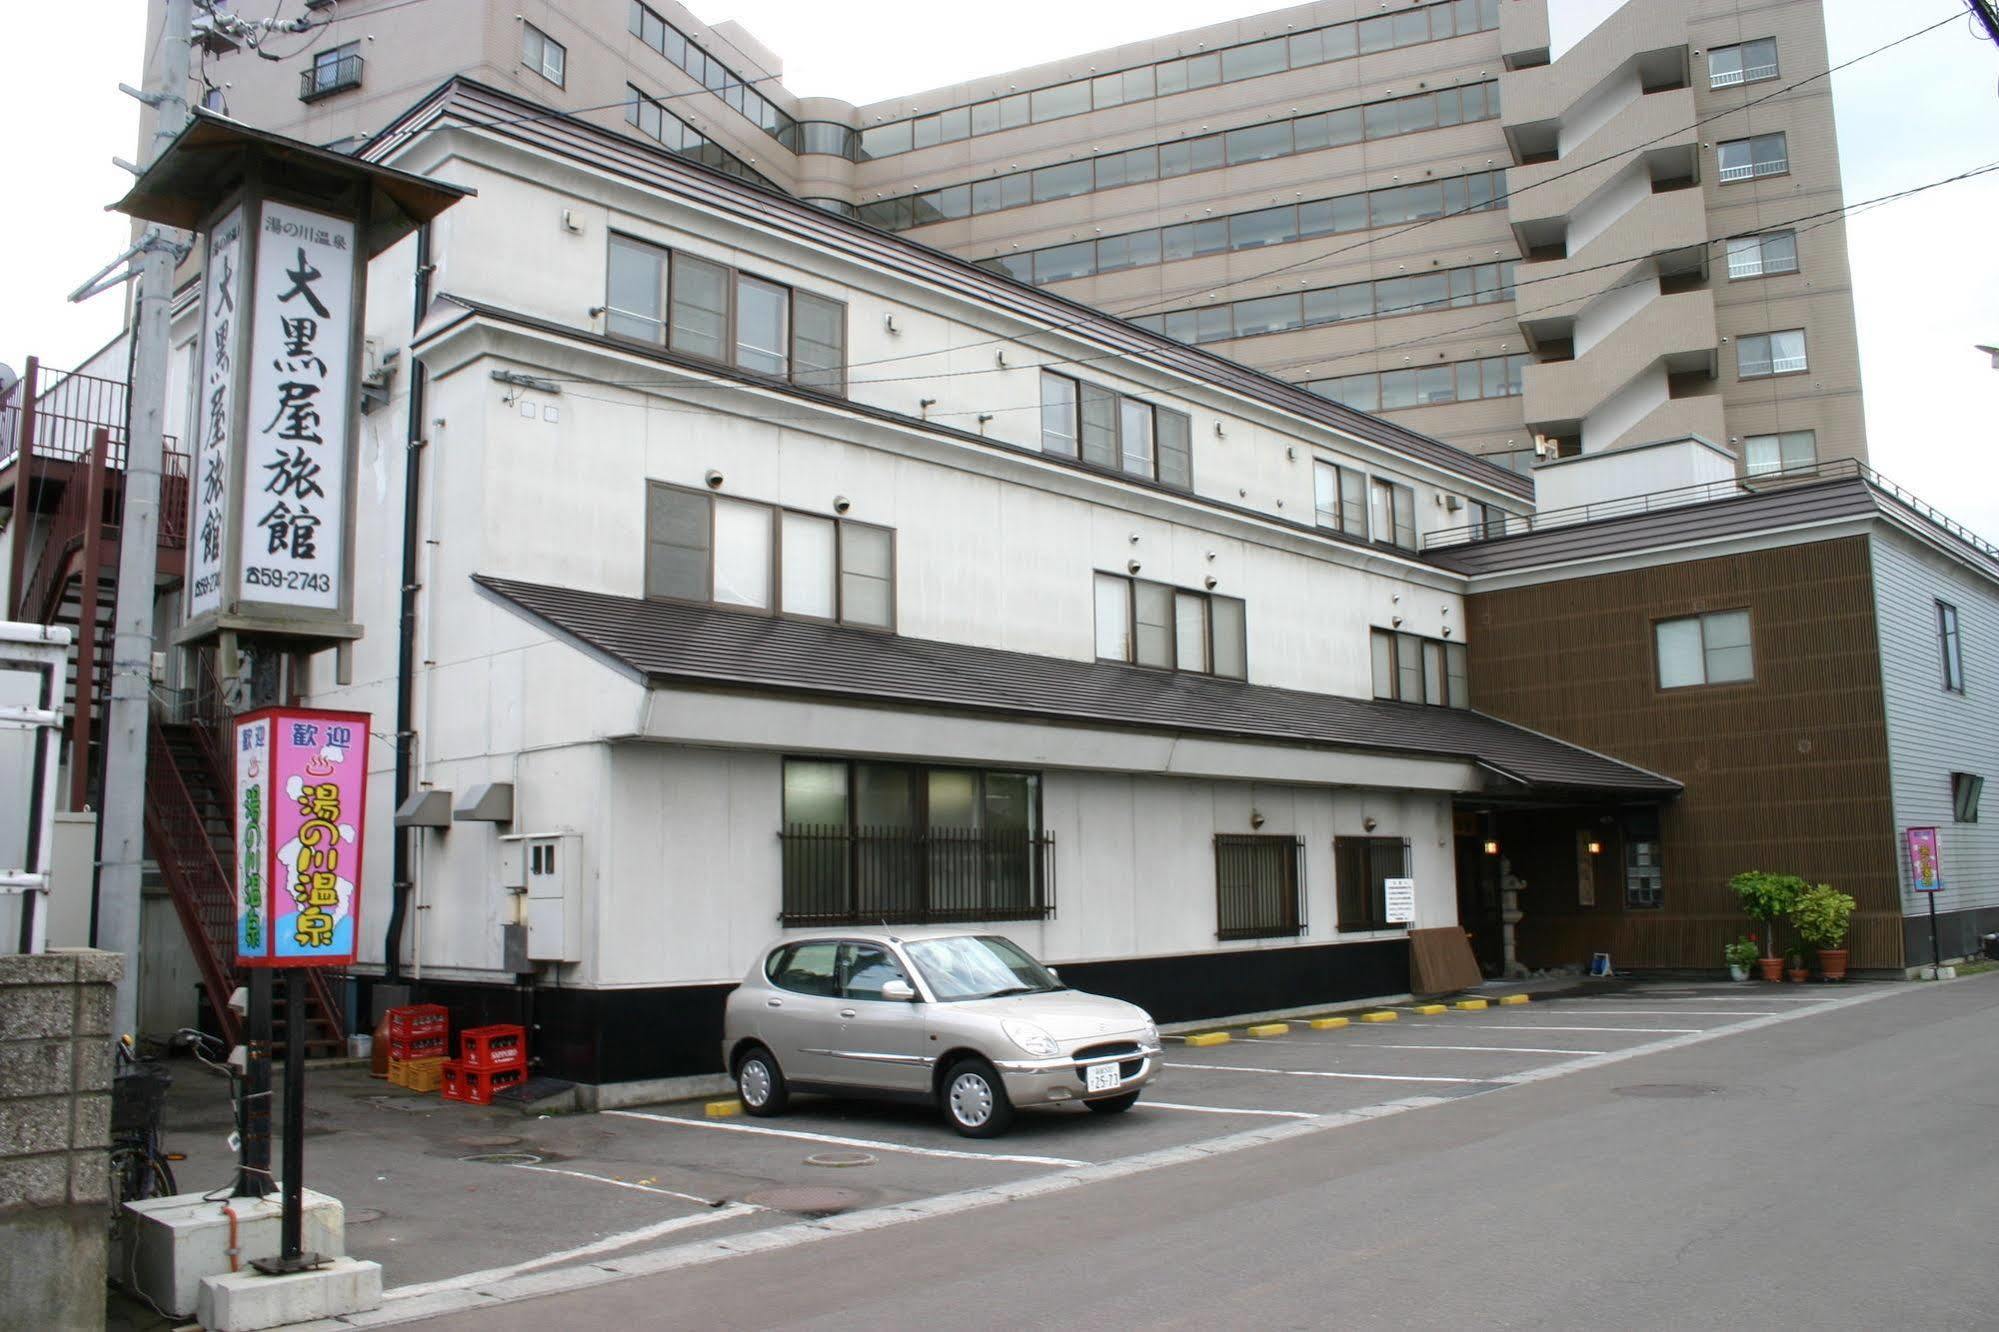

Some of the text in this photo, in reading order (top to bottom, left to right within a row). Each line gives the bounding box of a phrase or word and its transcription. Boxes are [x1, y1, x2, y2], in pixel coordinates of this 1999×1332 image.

[265, 216, 347, 250] 湯の川温泉
[257, 247, 331, 559] 大黒屋旅館
[260, 568, 330, 592] 59-2743
[244, 784, 262, 949] 湯の川温泉
[294, 783, 341, 947] 湯の川温泉
